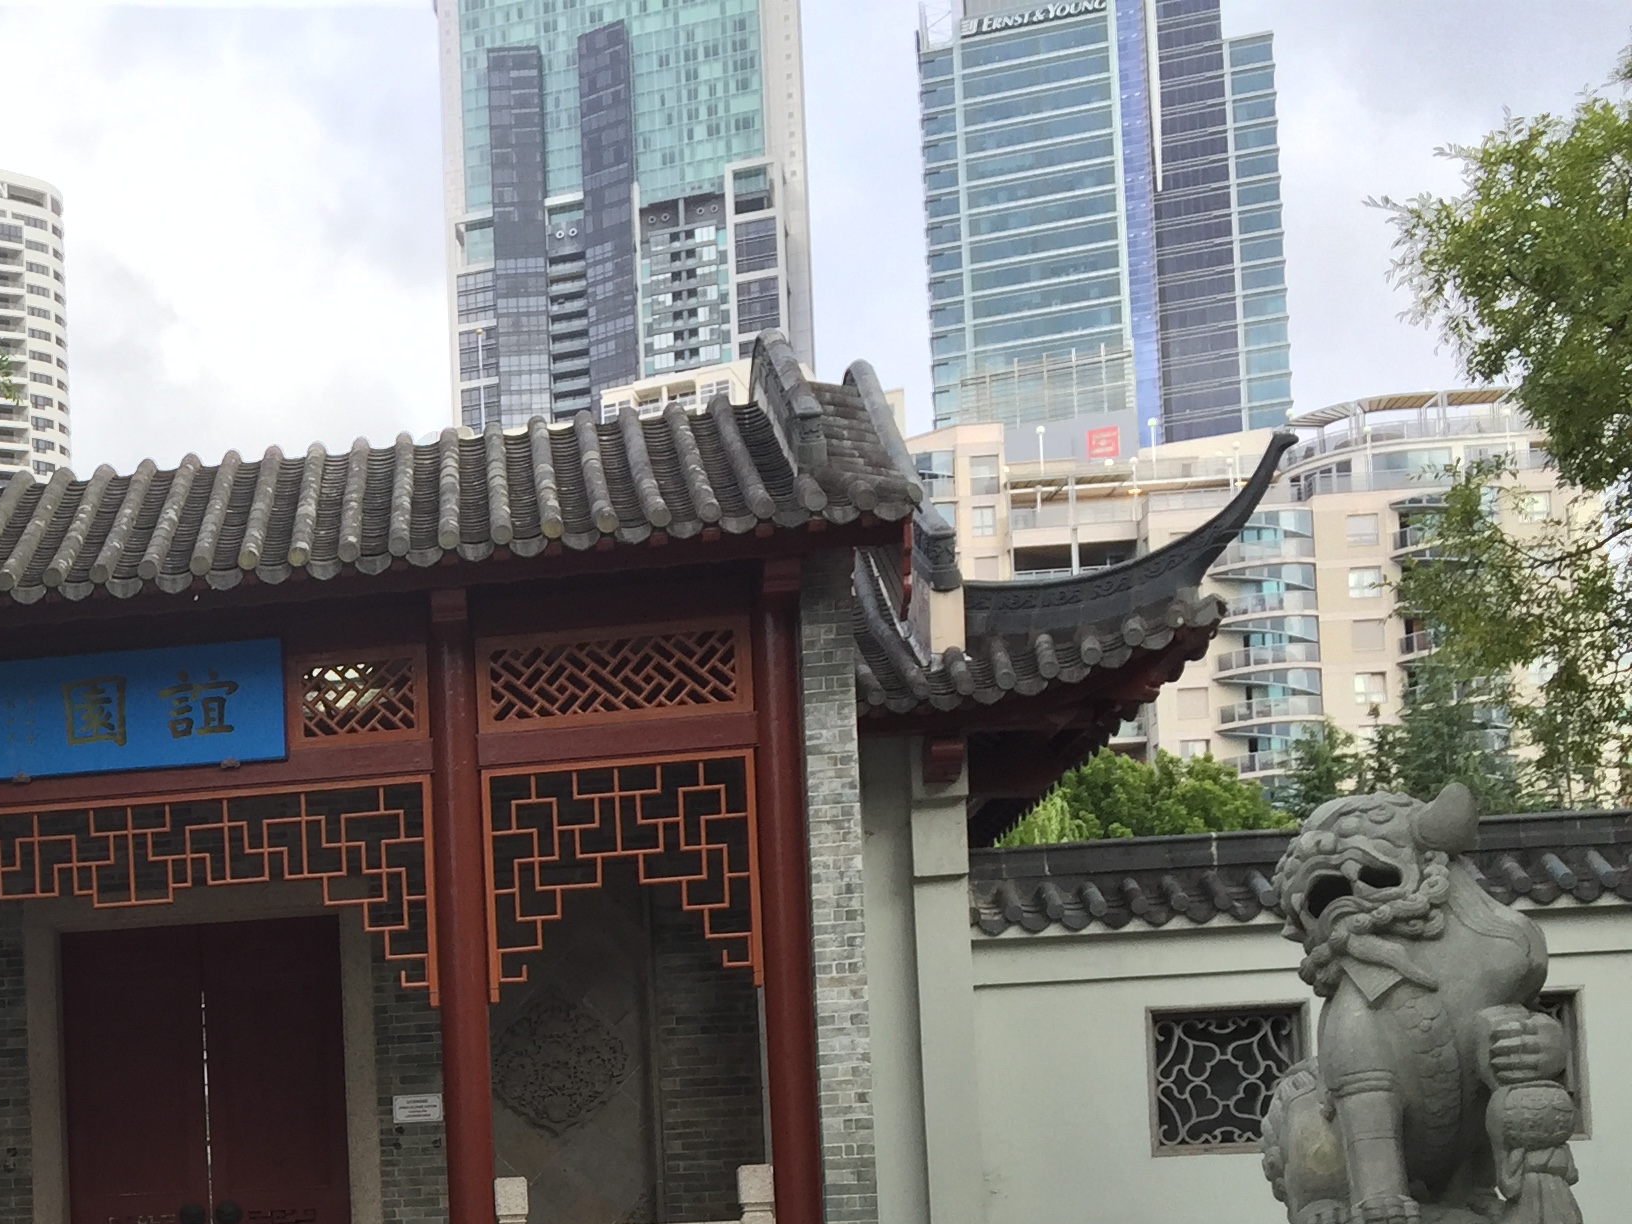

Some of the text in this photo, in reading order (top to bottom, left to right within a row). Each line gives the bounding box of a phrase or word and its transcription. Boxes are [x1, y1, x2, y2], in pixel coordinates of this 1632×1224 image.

[982, 0, 1107, 32] ERNST & YOUNG
